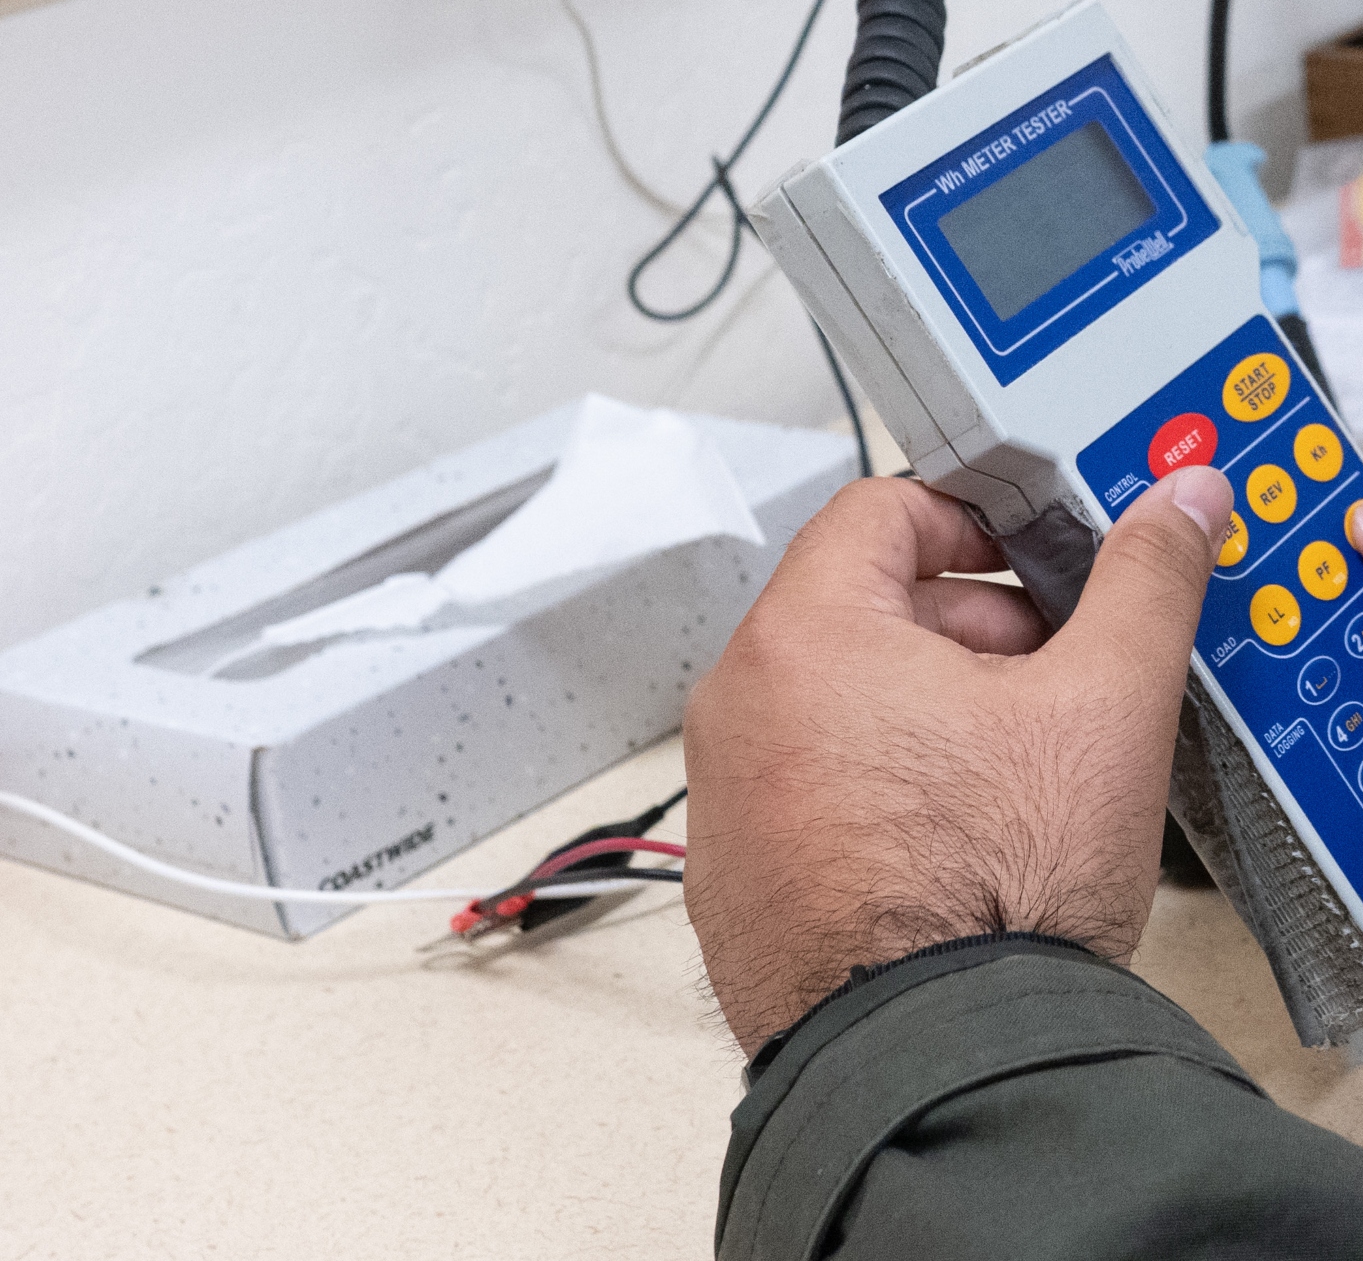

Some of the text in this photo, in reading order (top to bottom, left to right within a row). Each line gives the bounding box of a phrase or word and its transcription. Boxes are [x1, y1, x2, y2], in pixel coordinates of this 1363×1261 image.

[935, 99, 1073, 194] Wh METER TESTER
[1234, 362, 1270, 397] START
[1248, 381, 1277, 411] STOP
[1164, 428, 1203, 466] RESET
[1311, 444, 1328, 462] Kh
[1104, 472, 1139, 503] CONTROL
[1260, 480, 1284, 506] REV
[1315, 561, 1332, 580] PF
[1268, 607, 1285, 625] LL
[1211, 636, 1237, 663] LOAD
[1305, 680, 1318, 697] 1
[1264, 722, 1285, 743] DATA
[1273, 725, 1305, 758] LOGGING
[1336, 712, 1363, 743] 4 GHI
[318, 821, 435, 891] COASTWIDE
